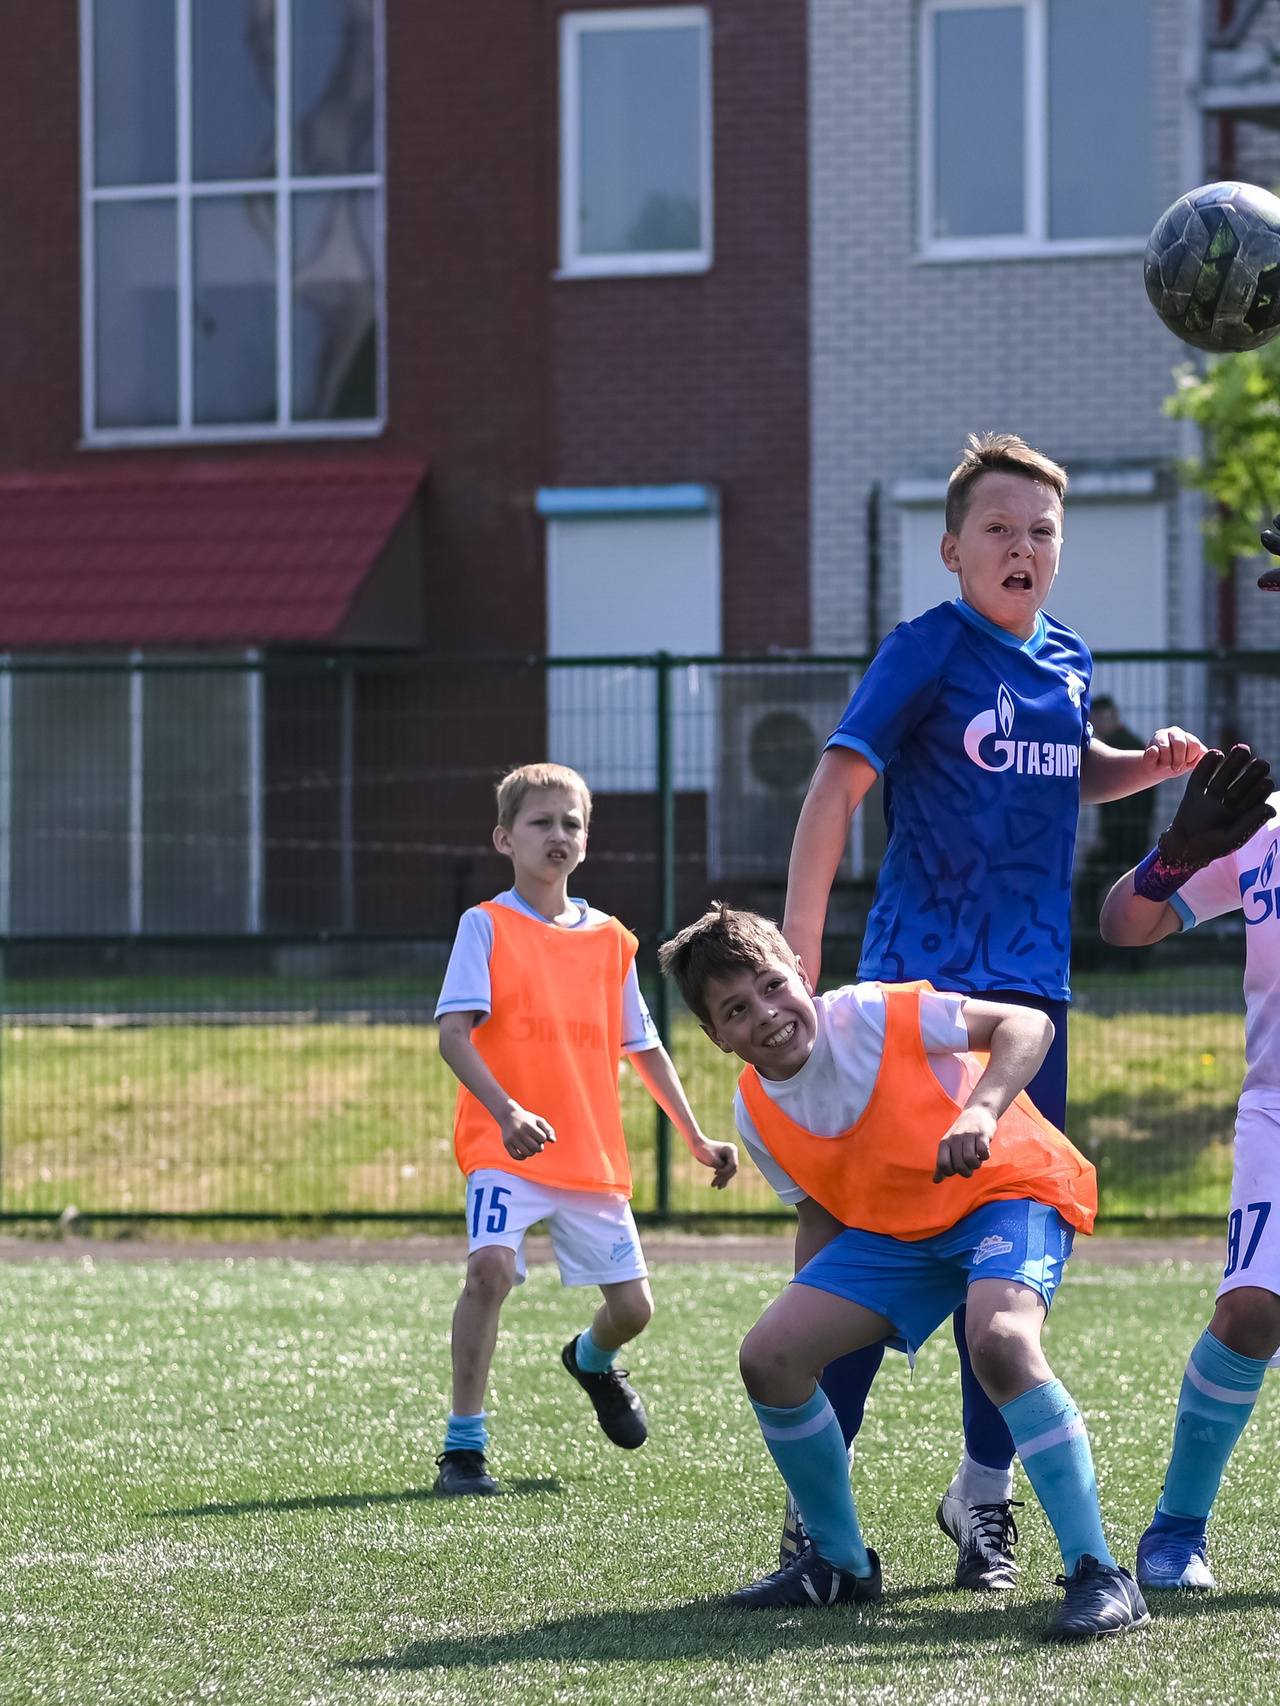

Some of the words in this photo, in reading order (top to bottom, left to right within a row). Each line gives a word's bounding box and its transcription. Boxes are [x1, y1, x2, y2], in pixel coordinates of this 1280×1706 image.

[1016, 741, 1081, 778] ГАЗПР
[472, 1186, 511, 1238] 15
[1224, 1201, 1271, 1279] 87
